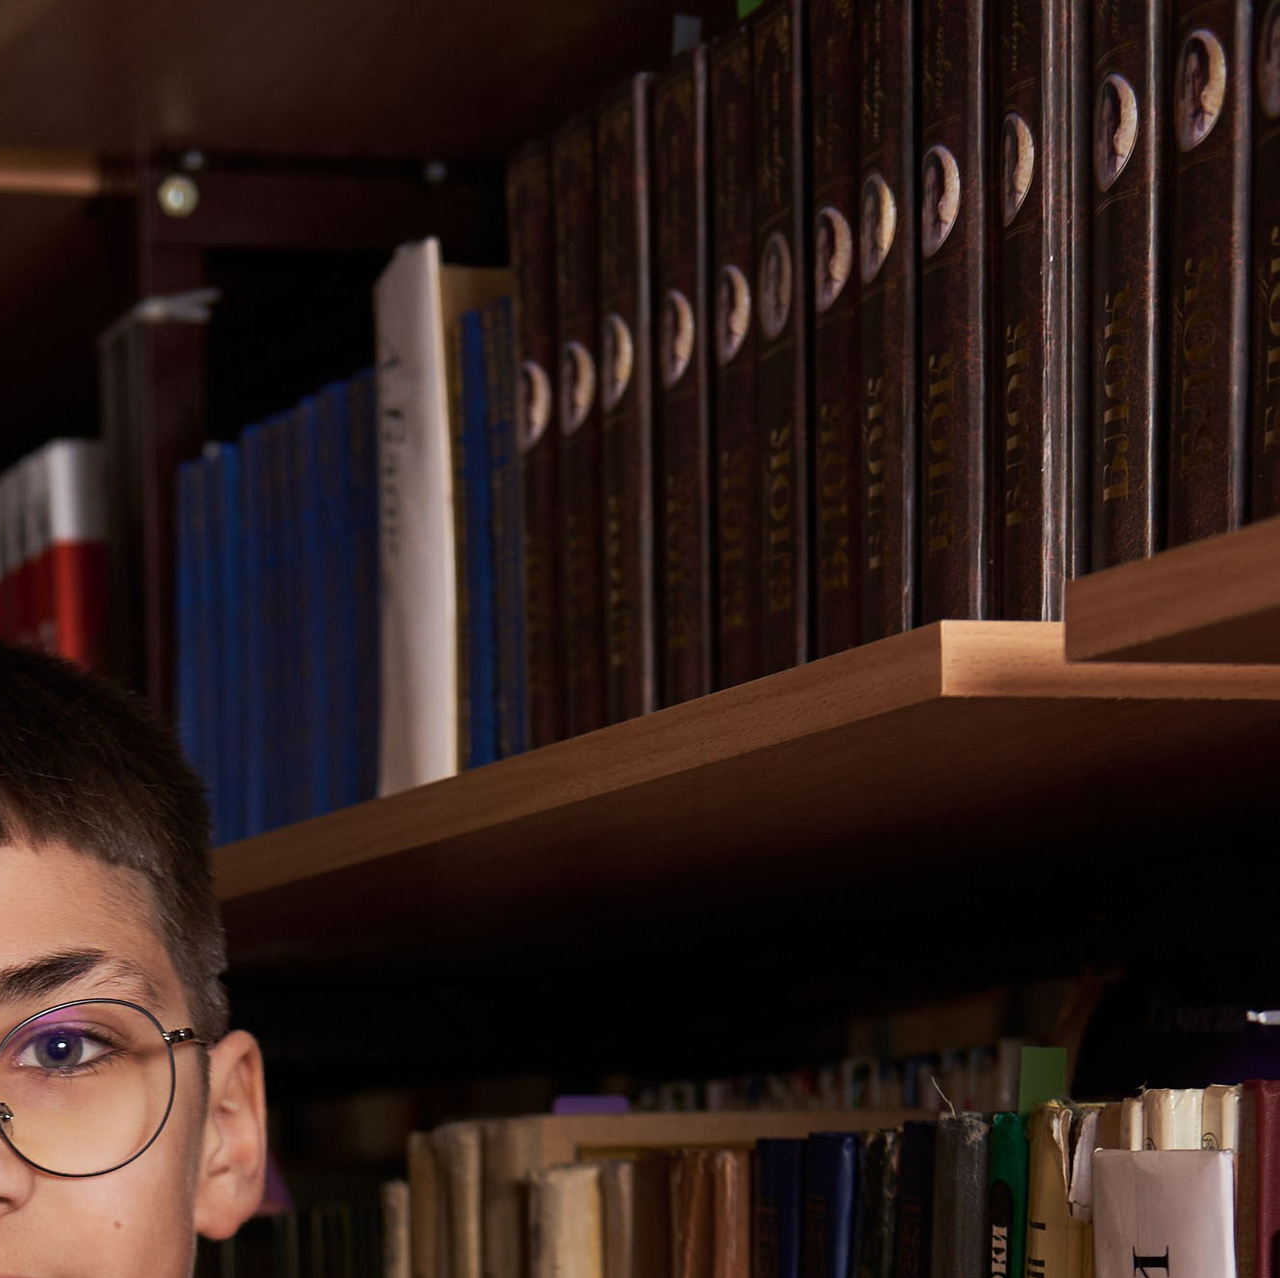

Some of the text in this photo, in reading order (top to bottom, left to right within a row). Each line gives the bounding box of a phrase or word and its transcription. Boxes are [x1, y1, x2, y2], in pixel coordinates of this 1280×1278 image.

[925, 349, 955, 553] БЛОК
[1004, 315, 1031, 529] БЛОК
[1101, 283, 1131, 505] БЛОК
[1180, 248, 1217, 475] БЛОК
[768, 421, 792, 617] БЛОК
[819, 398, 850, 592] БЛОК
